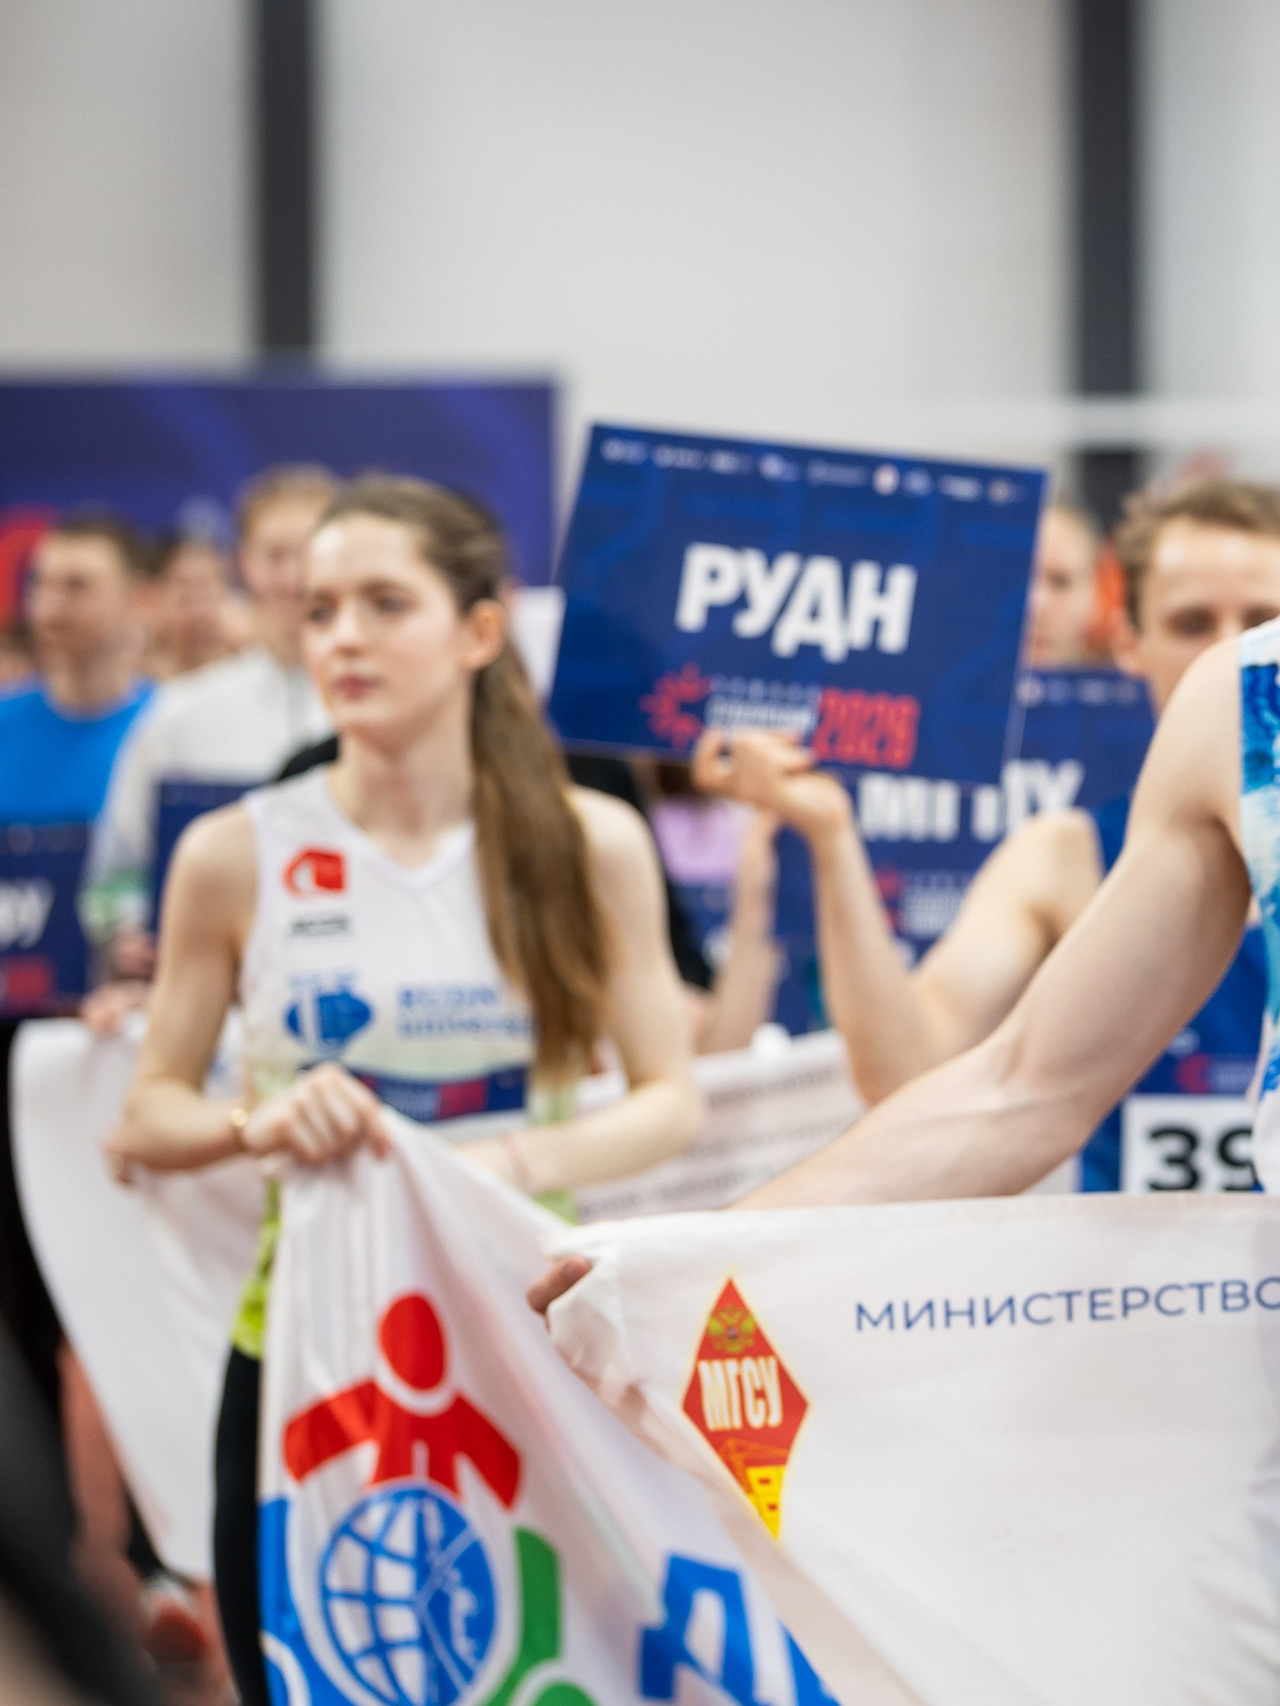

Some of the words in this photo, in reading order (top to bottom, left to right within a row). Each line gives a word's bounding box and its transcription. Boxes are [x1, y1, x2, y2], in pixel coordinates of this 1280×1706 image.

[674, 541, 918, 664] РУДН
[812, 687, 921, 769] 2026
[697, 1355, 784, 1432] МГСУ
